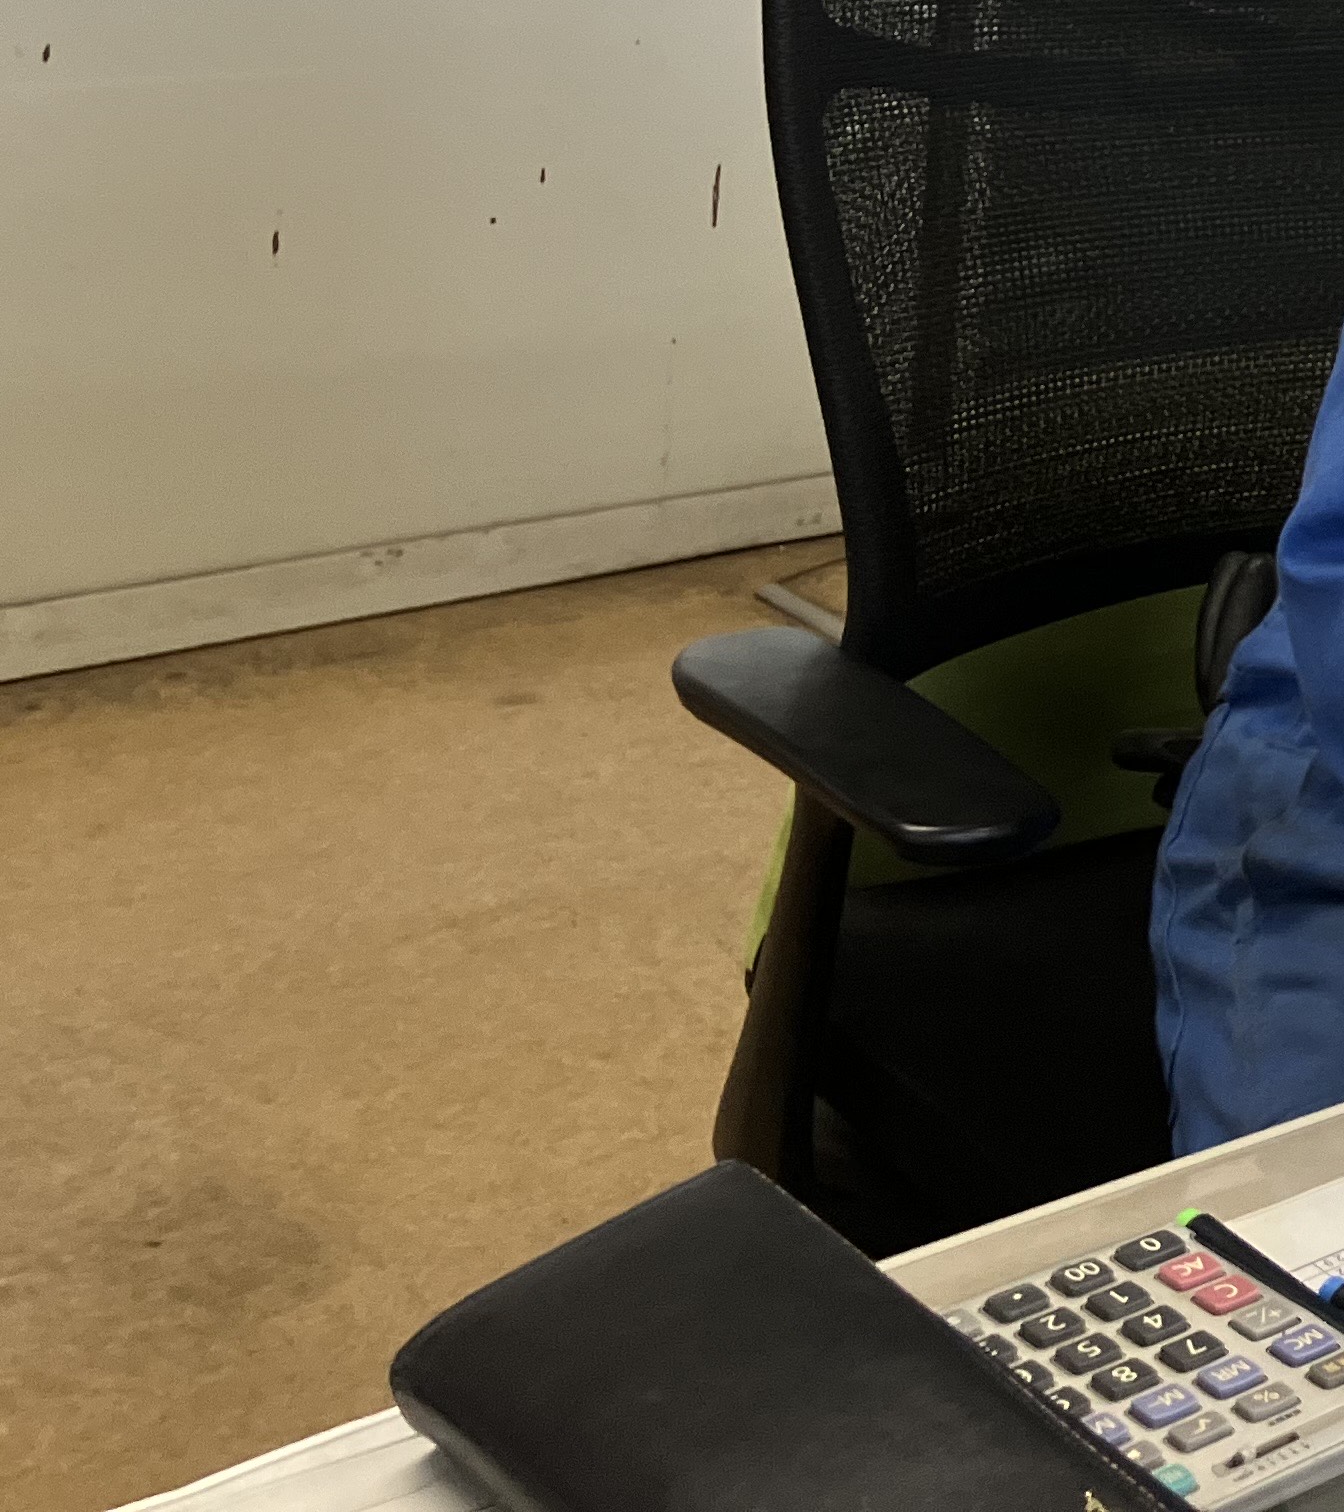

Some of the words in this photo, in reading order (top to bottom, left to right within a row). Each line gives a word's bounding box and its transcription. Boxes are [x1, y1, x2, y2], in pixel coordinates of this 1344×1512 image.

[1139, 1237, 1162, 1251] 0
[1064, 1261, 1100, 1281] 00
[1171, 1256, 1205, 1277] AC
[1109, 1289, 1129, 1304] 1
[1213, 1283, 1239, 1299] C
[1039, 1314, 1067, 1331] 2
[1143, 1313, 1164, 1328] 4
[1185, 1338, 1208, 1356] 7
[1291, 1328, 1325, 1351] MC
[1077, 1340, 1102, 1358] 5
[1111, 1365, 1138, 1382] 8
[1210, 1360, 1252, 1381] MR
